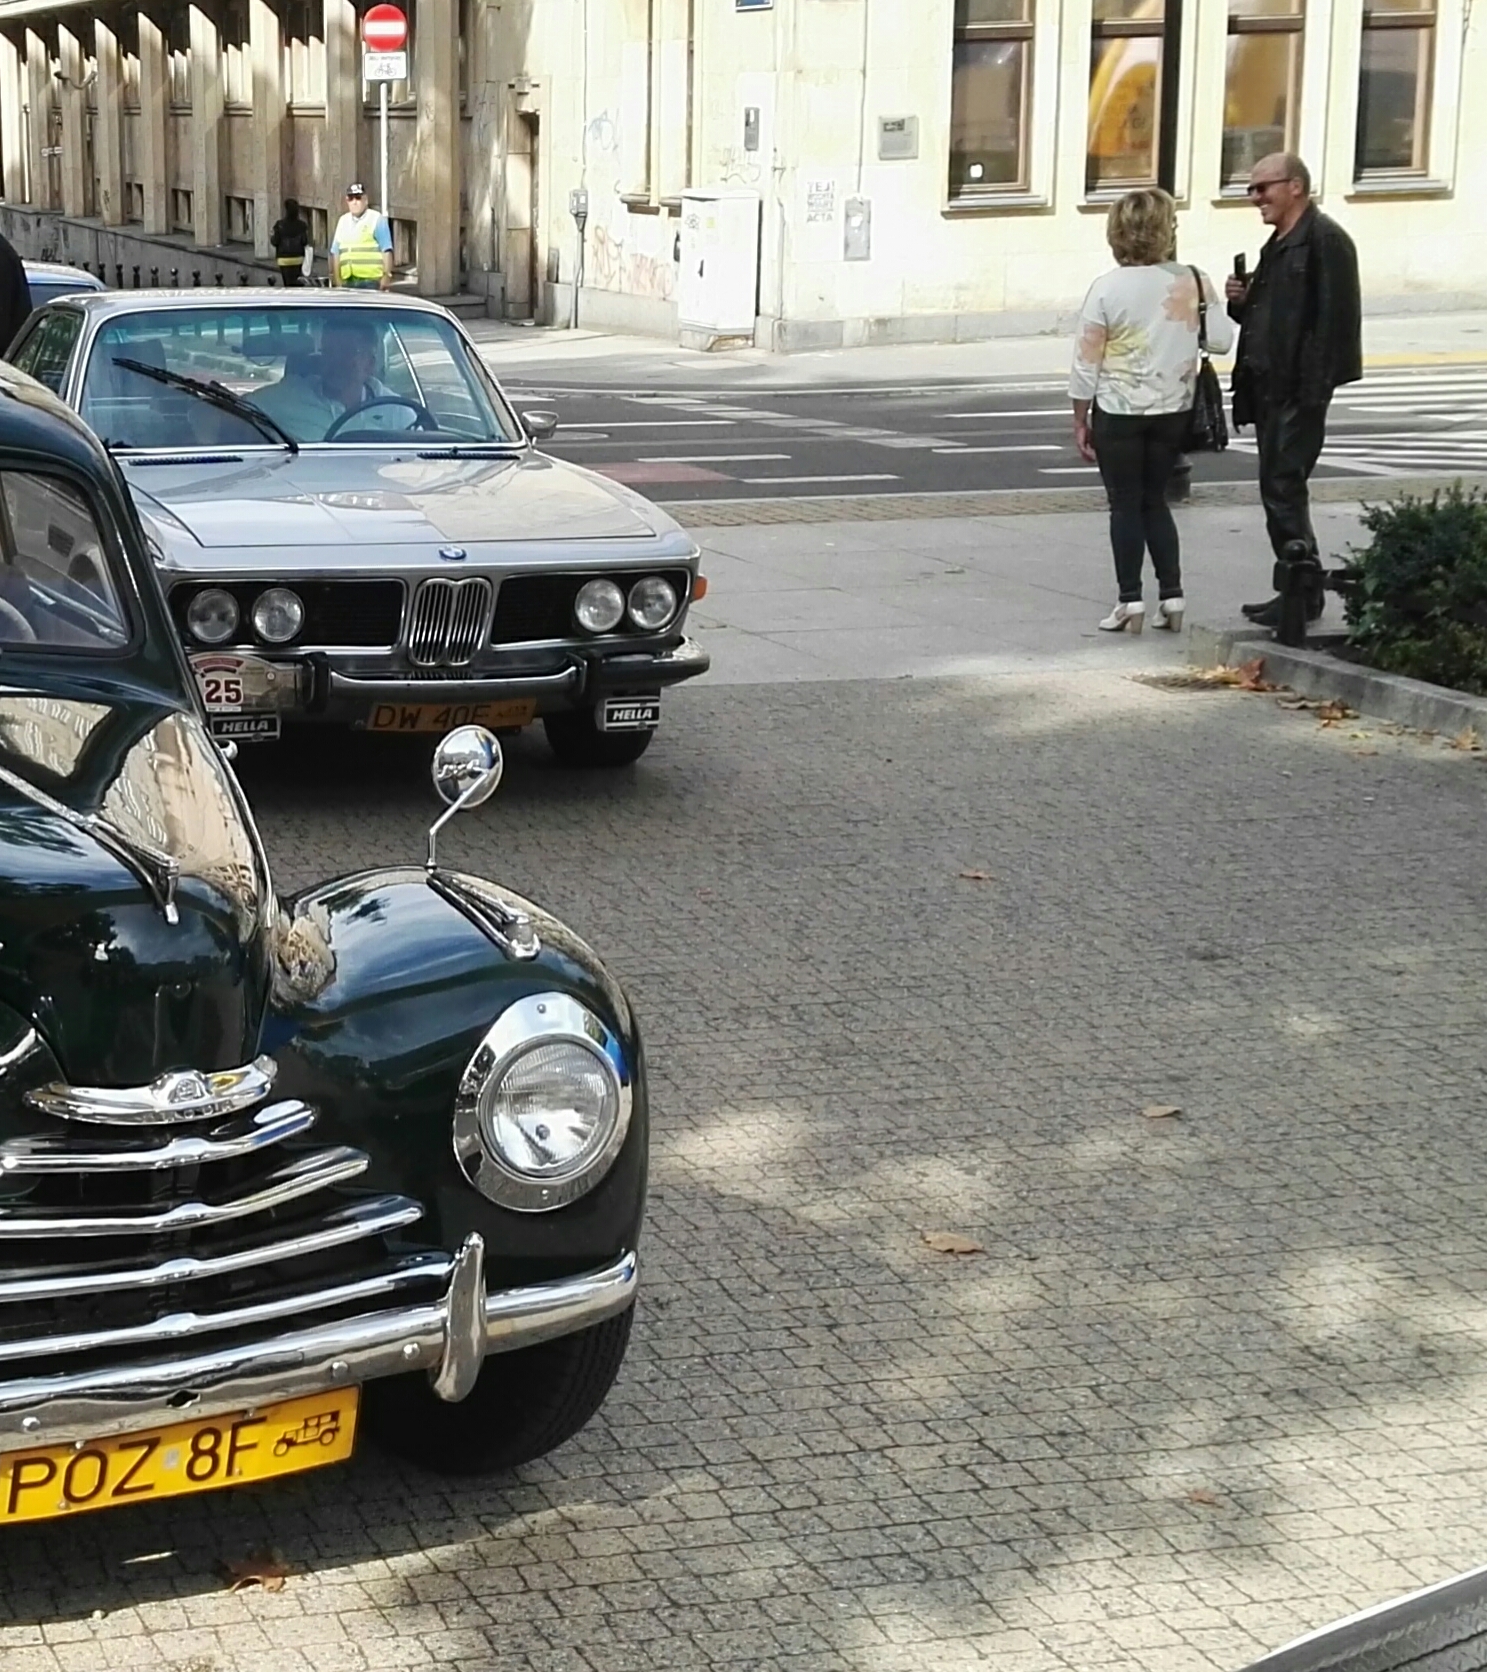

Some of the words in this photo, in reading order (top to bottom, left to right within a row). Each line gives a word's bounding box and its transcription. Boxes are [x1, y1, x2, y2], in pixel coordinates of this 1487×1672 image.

[205, 679, 242, 703] 25
[221, 720, 268, 733] HELLA
[373, 704, 422, 729] DW
[613, 708, 653, 721] HELLA
[7, 1436, 162, 1515] POZ
[185, 1416, 267, 1482] 8F
